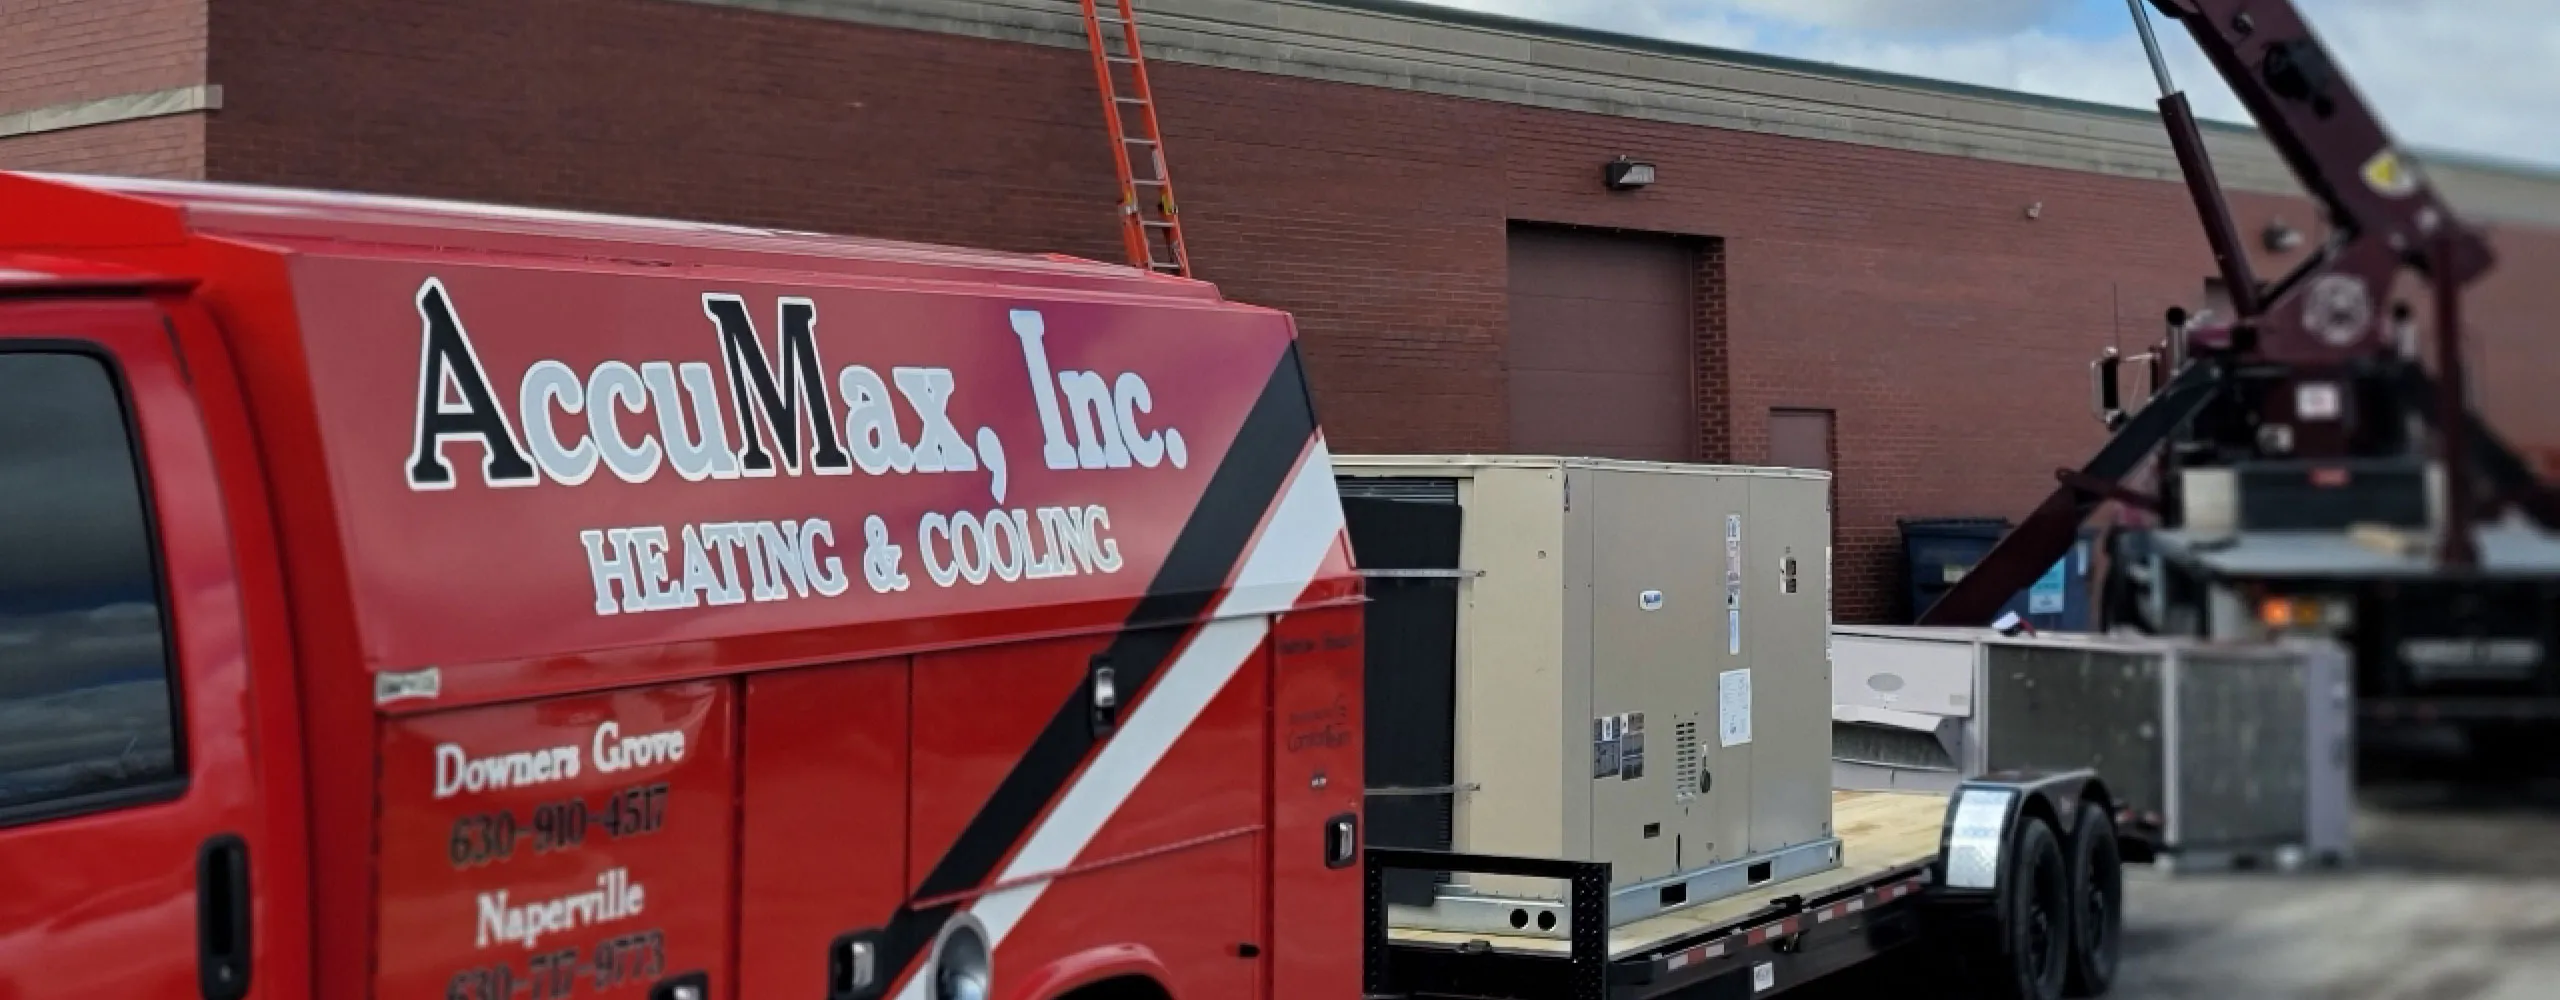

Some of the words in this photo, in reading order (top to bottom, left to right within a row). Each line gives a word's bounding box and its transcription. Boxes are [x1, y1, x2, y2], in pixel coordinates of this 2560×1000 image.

[406, 276, 1008, 503] AccuMax,
[1010, 309, 1188, 470] Inc.
[582, 519, 850, 615] HEATING
[862, 515, 910, 593] &
[918, 505, 1123, 587] COOLING
[434, 743, 580, 797] Downers
[593, 722, 685, 773] Grove
[450, 783, 669, 868] 630-910-4517
[475, 869, 644, 947] Naperville
